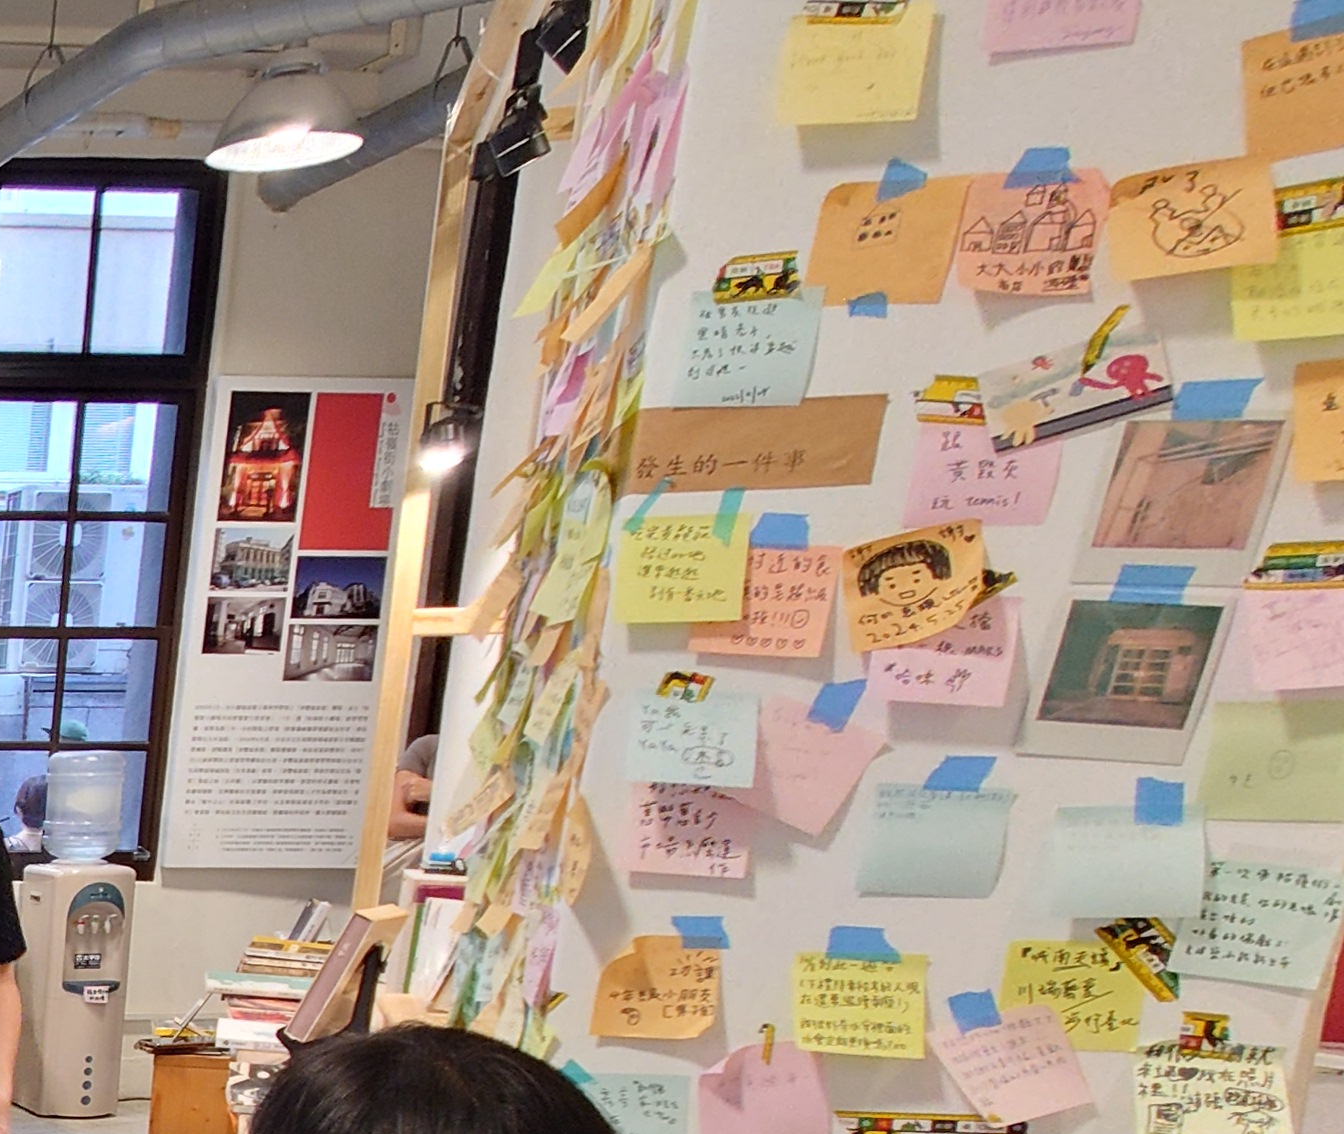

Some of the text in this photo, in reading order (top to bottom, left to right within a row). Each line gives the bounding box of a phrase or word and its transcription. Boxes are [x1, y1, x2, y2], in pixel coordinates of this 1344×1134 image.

[635, 450, 806, 479] 發生的一件事
